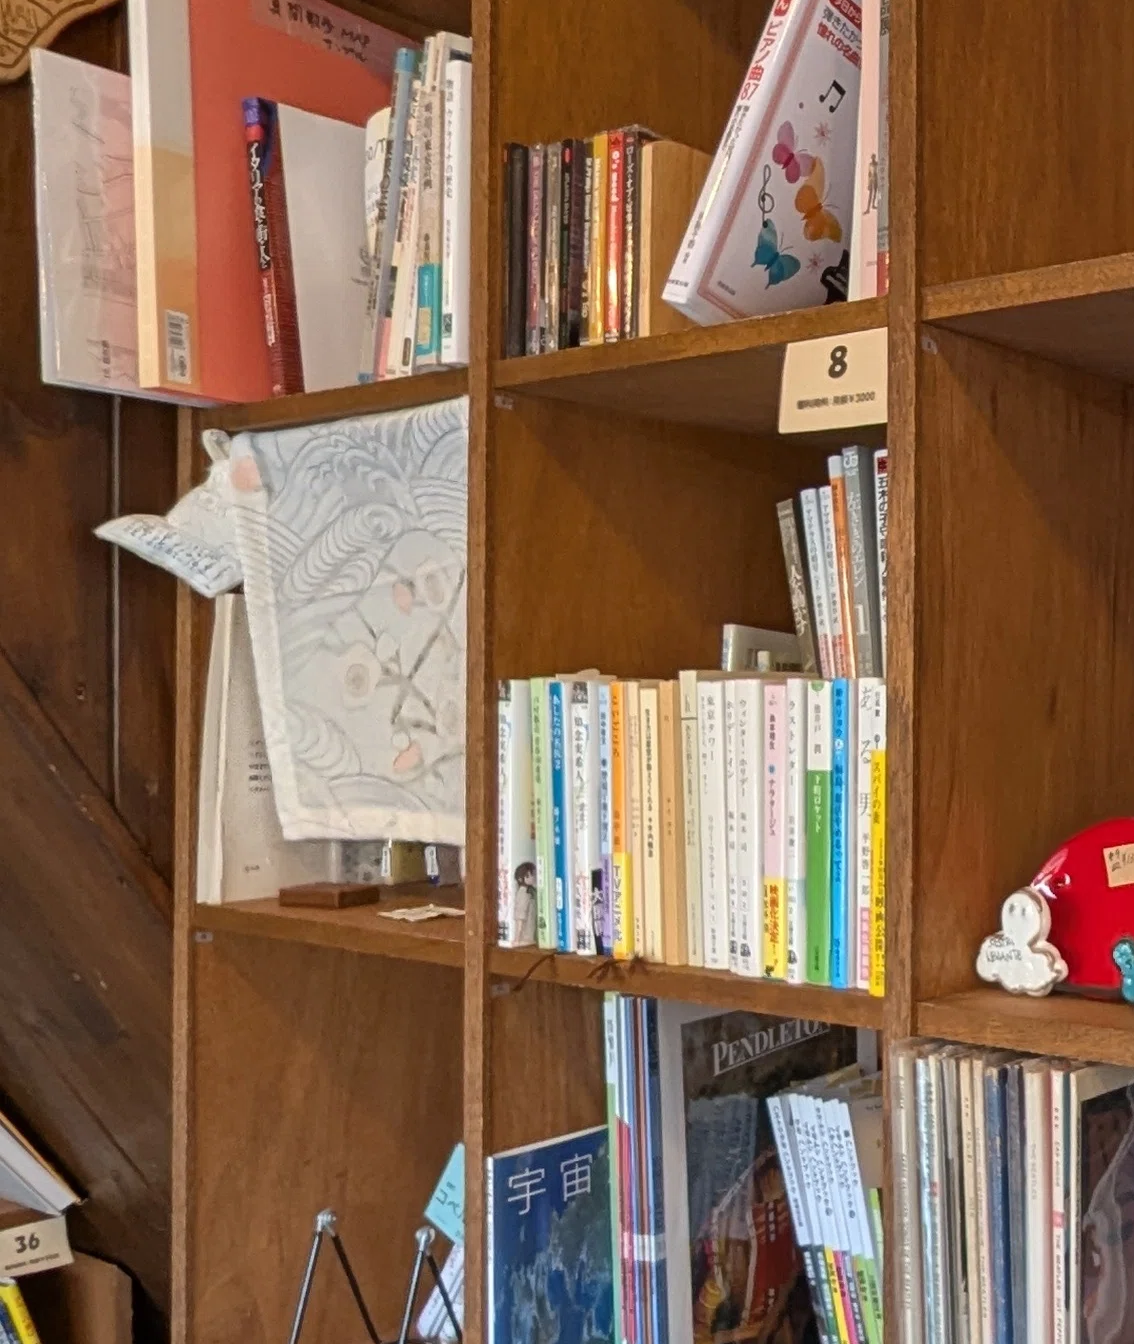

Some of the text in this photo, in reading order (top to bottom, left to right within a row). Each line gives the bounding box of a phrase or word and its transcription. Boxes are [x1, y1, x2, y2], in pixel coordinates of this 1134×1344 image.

[828, 344, 848, 379] 8
[707, 695, 716, 762] 東京タワー
[787, 698, 796, 787] ラストレター
[507, 1151, 593, 1216] 宇宙
[14, 1232, 41, 1255] 36
